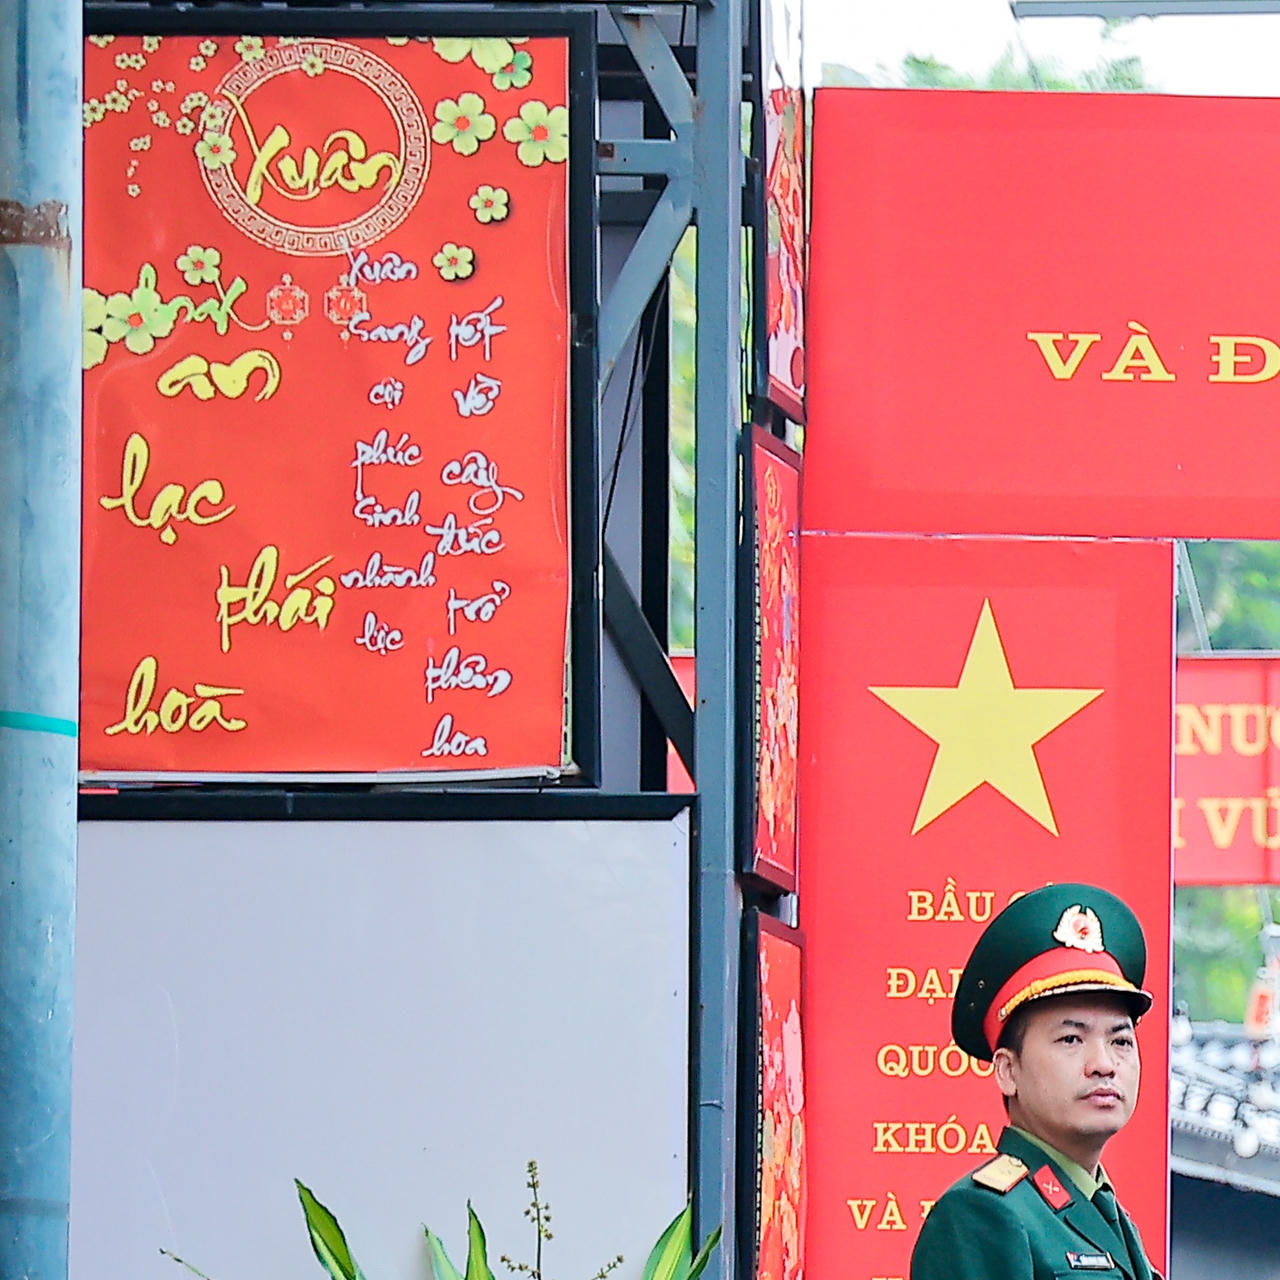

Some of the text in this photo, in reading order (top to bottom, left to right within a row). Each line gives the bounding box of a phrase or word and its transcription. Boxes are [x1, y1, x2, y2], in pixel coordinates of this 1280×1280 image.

[1026, 320, 1177, 382] VÀ
[906, 876, 996, 923] BẦU
[885, 967, 965, 1006] ĐẠI
[873, 1115, 998, 1154] KHÓA
[845, 1190, 908, 1231] VÀ
